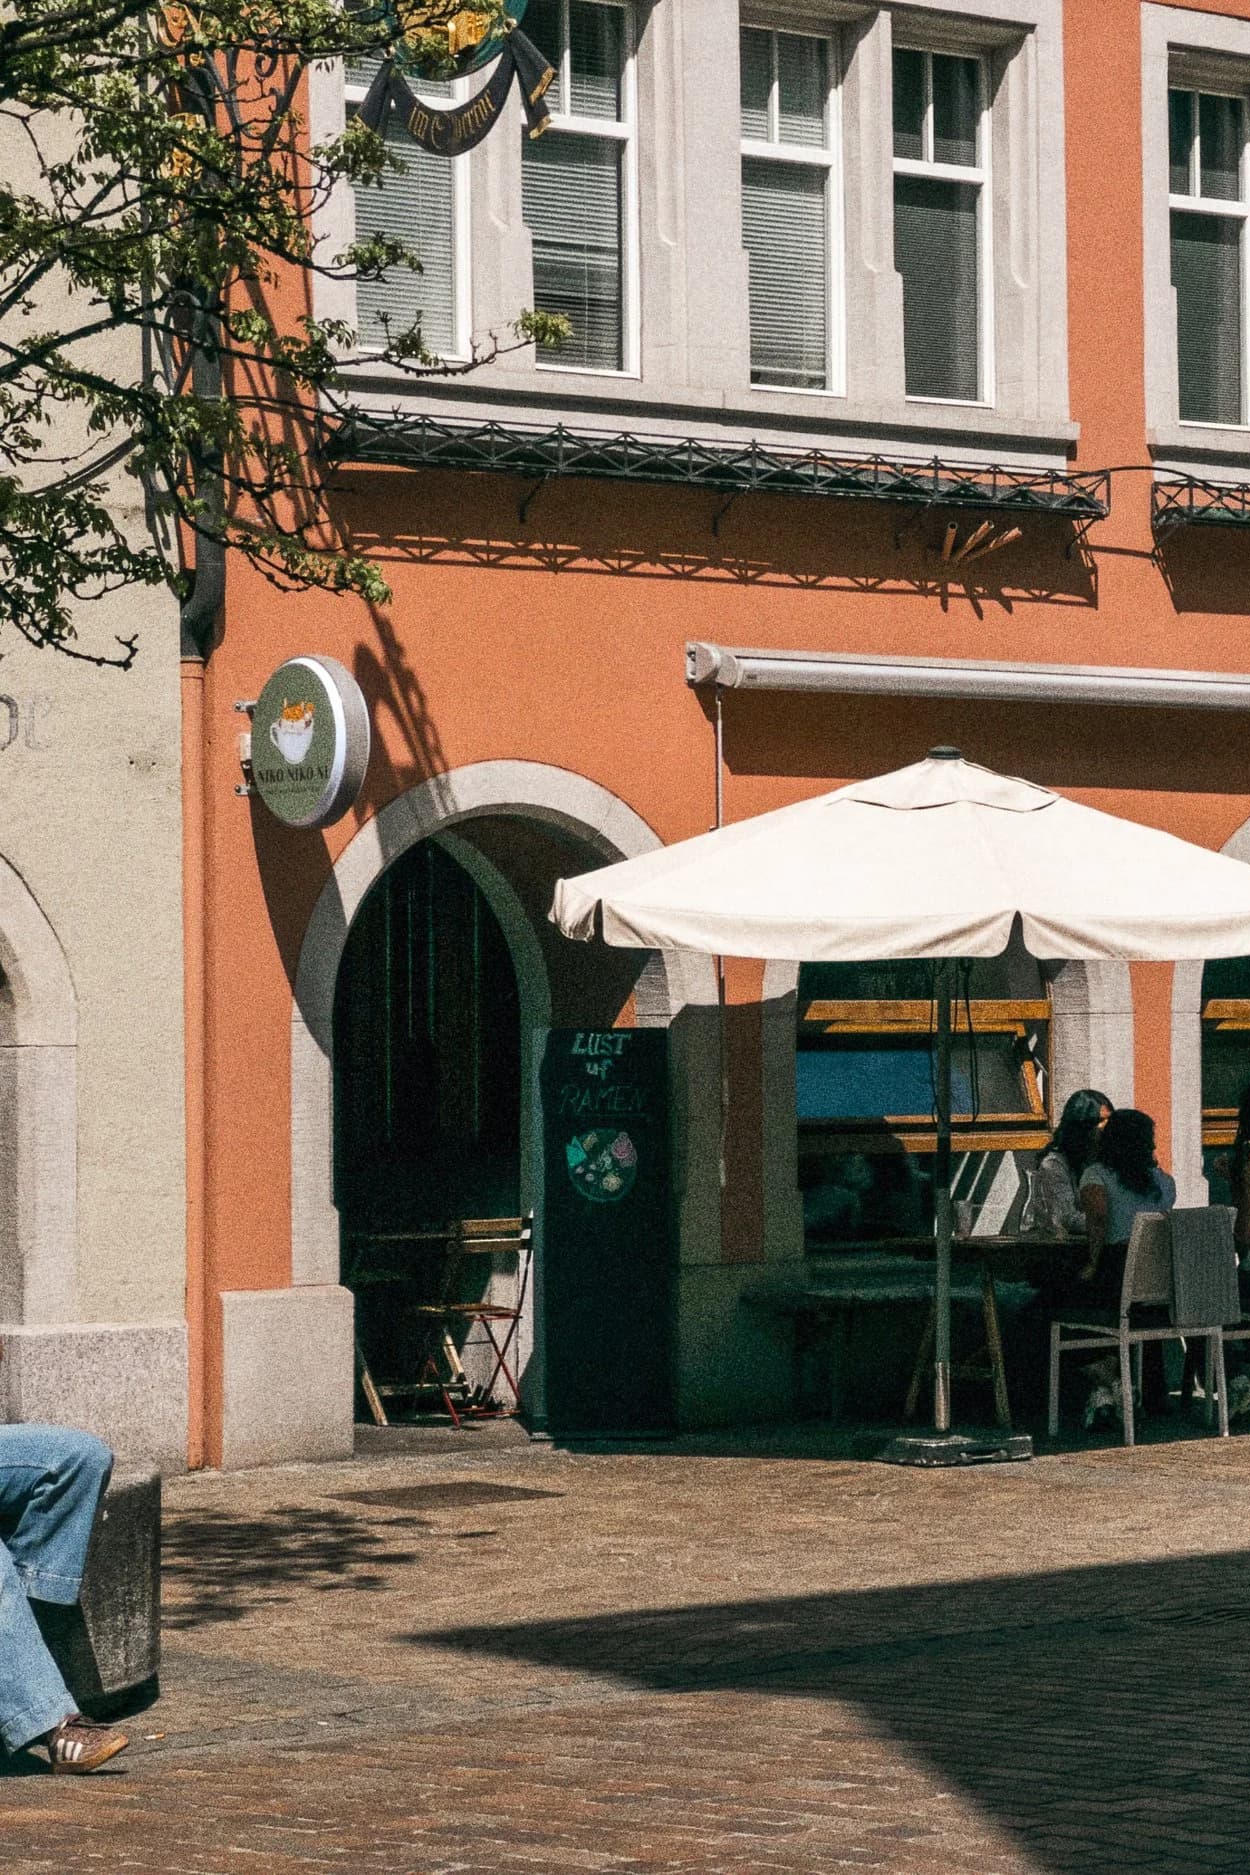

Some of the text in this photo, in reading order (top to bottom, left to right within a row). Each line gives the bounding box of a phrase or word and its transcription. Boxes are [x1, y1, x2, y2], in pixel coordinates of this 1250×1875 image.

[258, 768, 284, 783] NIKO
[288, 766, 314, 781] NIKO
[571, 1032, 632, 1056] LUST
[558, 1083, 647, 1114] RAMEN
